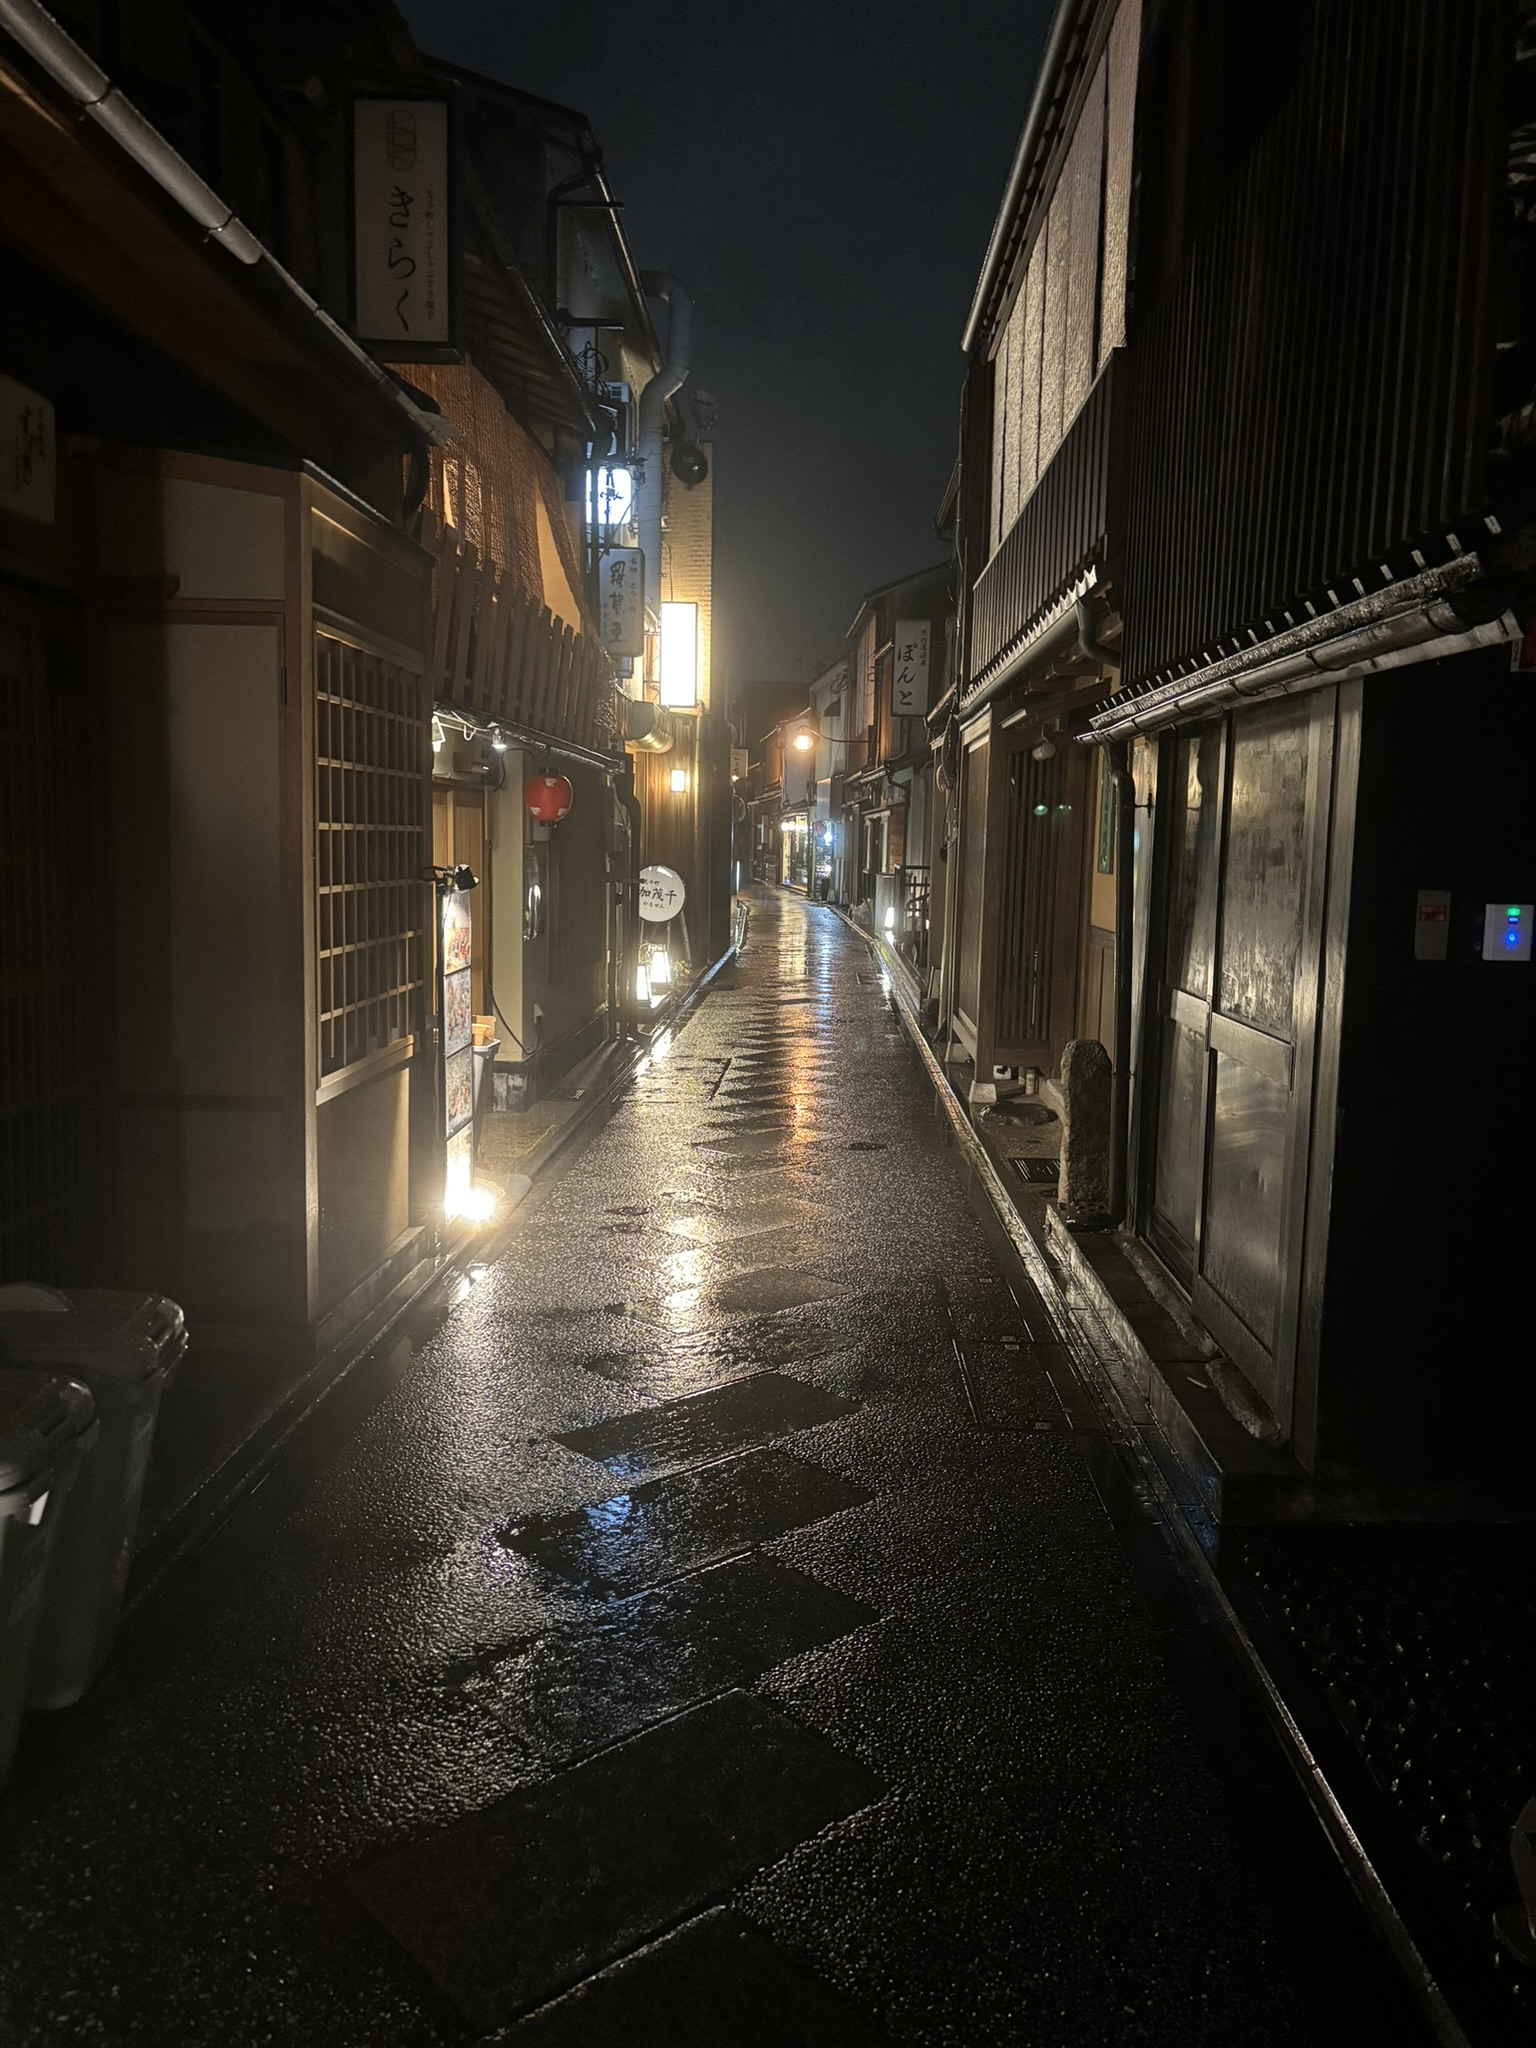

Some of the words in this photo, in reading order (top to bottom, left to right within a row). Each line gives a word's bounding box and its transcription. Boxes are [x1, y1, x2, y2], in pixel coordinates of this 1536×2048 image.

[387, 184, 416, 332] きらく
[897, 642, 918, 706] ぽんと
[639, 886, 677, 906] 加茂千
